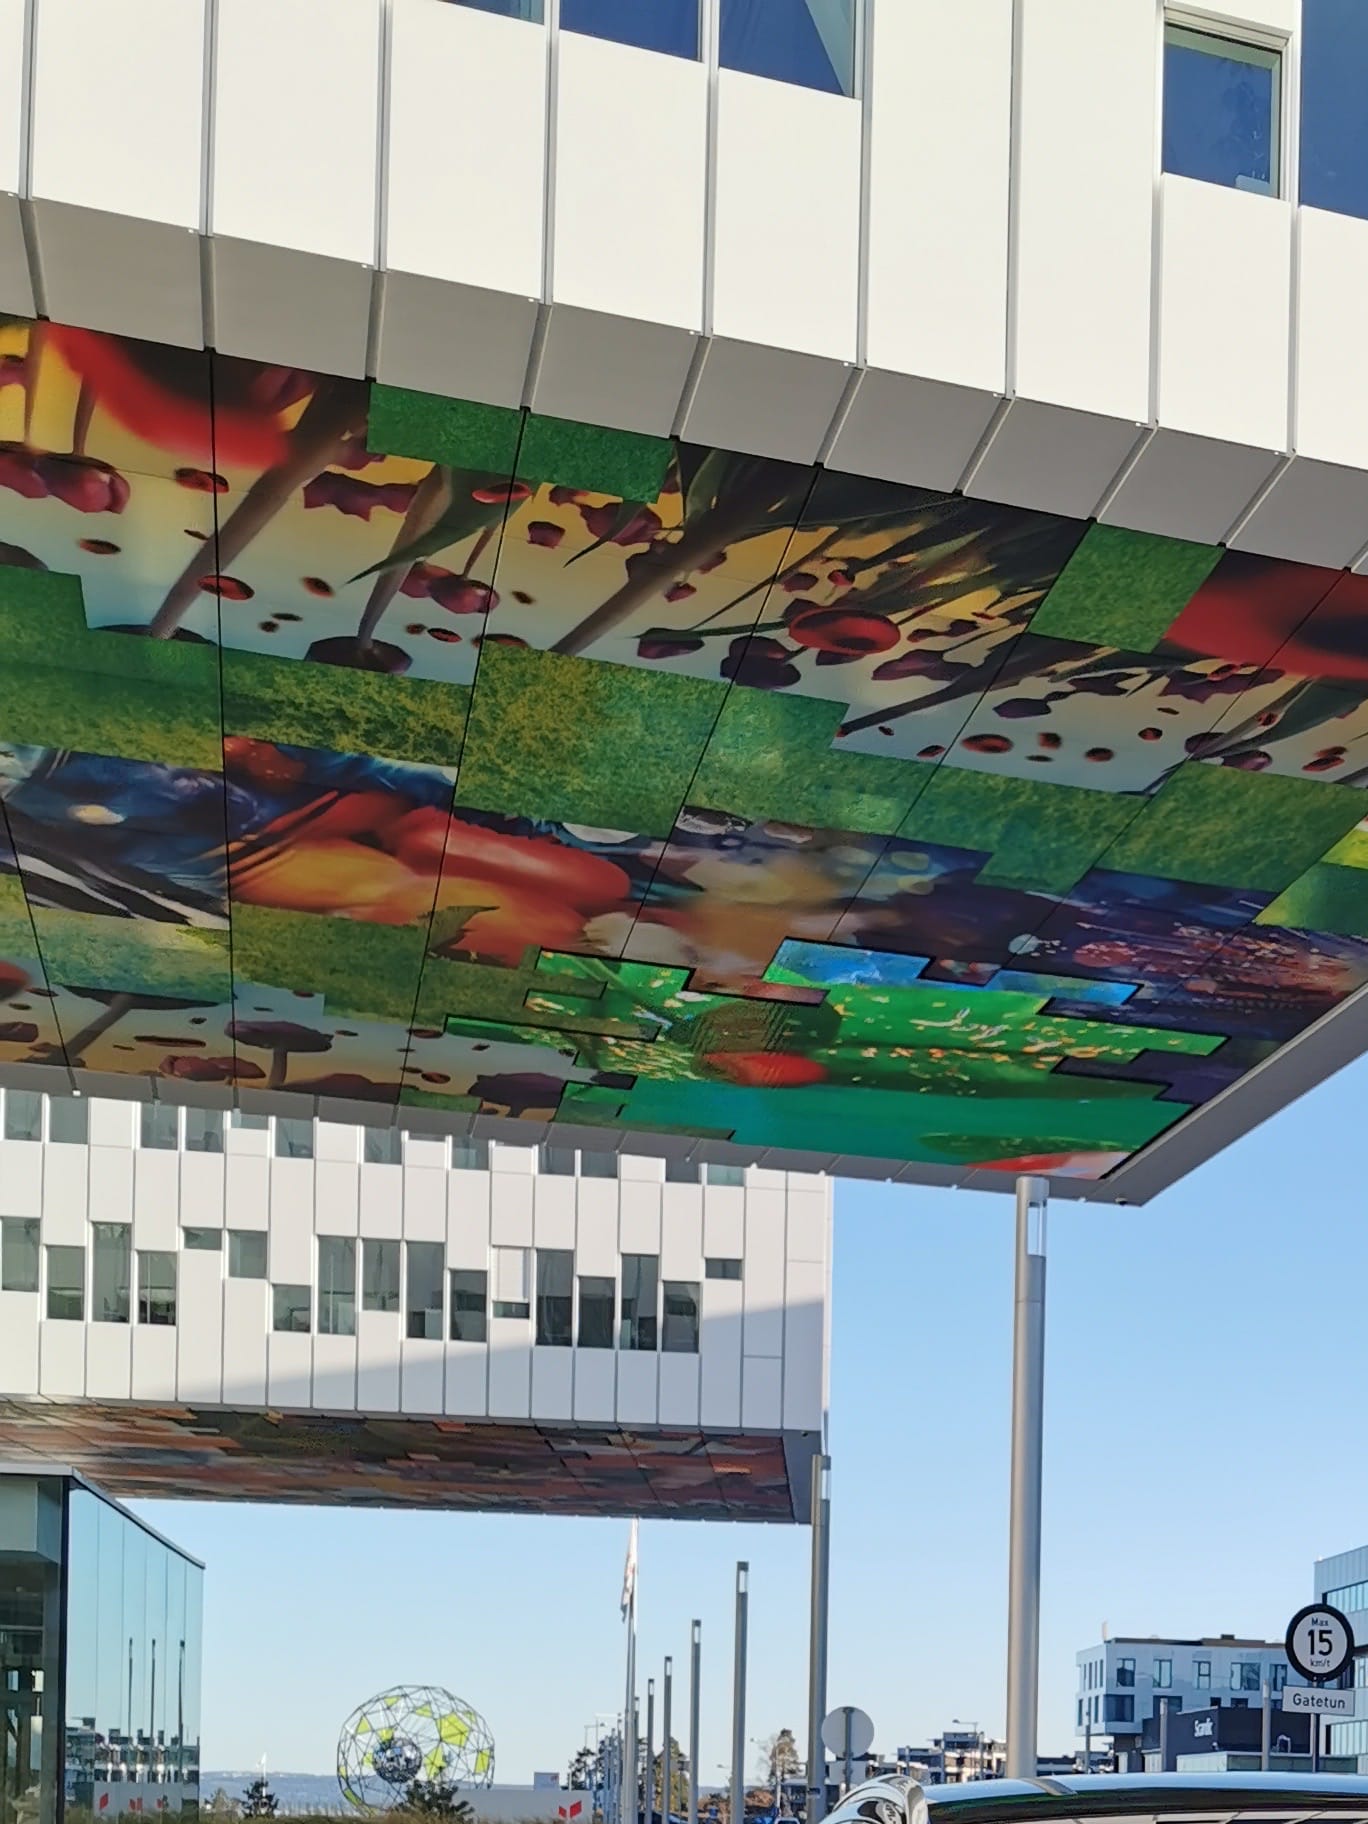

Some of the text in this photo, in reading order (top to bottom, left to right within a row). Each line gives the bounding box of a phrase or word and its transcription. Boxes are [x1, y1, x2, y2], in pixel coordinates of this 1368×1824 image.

[1311, 1618, 1328, 1626] Max
[1307, 1629, 1333, 1656] 15
[1310, 1659, 1331, 1667] km/t
[1293, 1693, 1346, 1709] Gatetun
